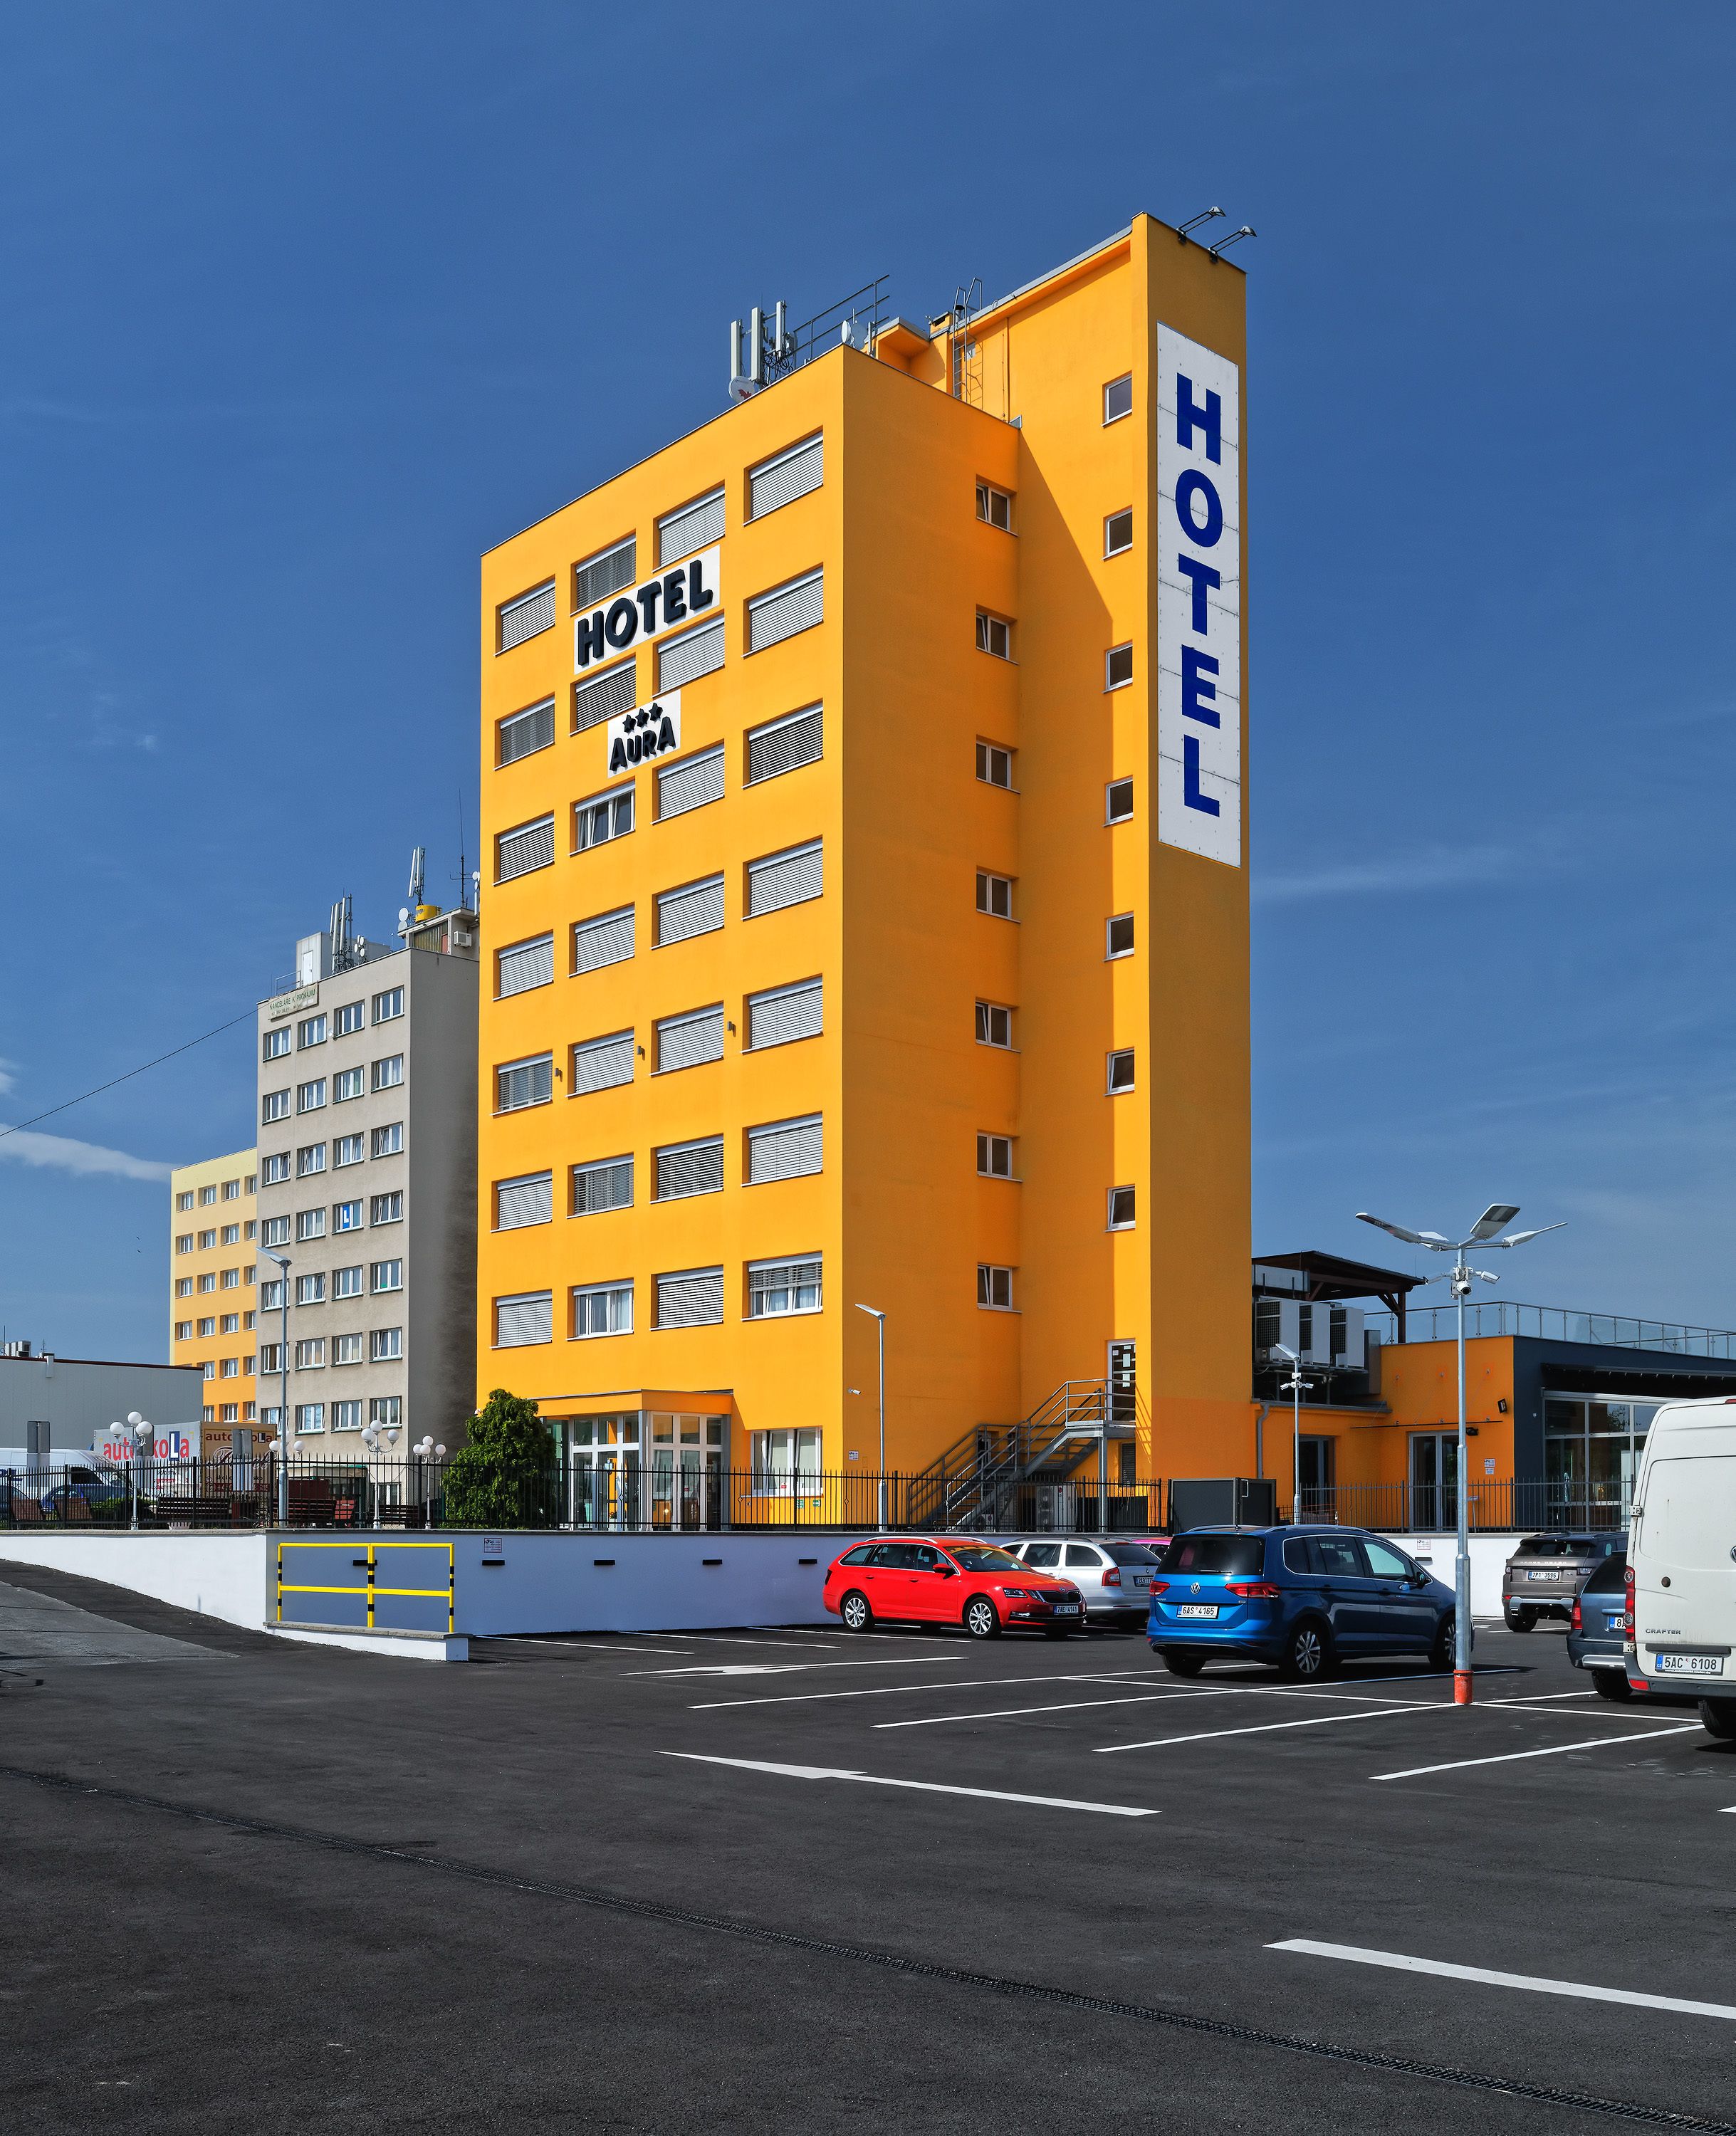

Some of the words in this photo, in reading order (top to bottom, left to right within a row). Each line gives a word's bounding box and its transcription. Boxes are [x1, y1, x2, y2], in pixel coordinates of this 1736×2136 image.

[577, 560, 713, 666] HOTEL
[1175, 372, 1223, 817] HOTEL
[610, 716, 676, 774] AURA
[1183, 1606, 1194, 1615] 6AS
[1665, 1657, 1683, 1668] 5AC
[1691, 1658, 1717, 1670] 6108
